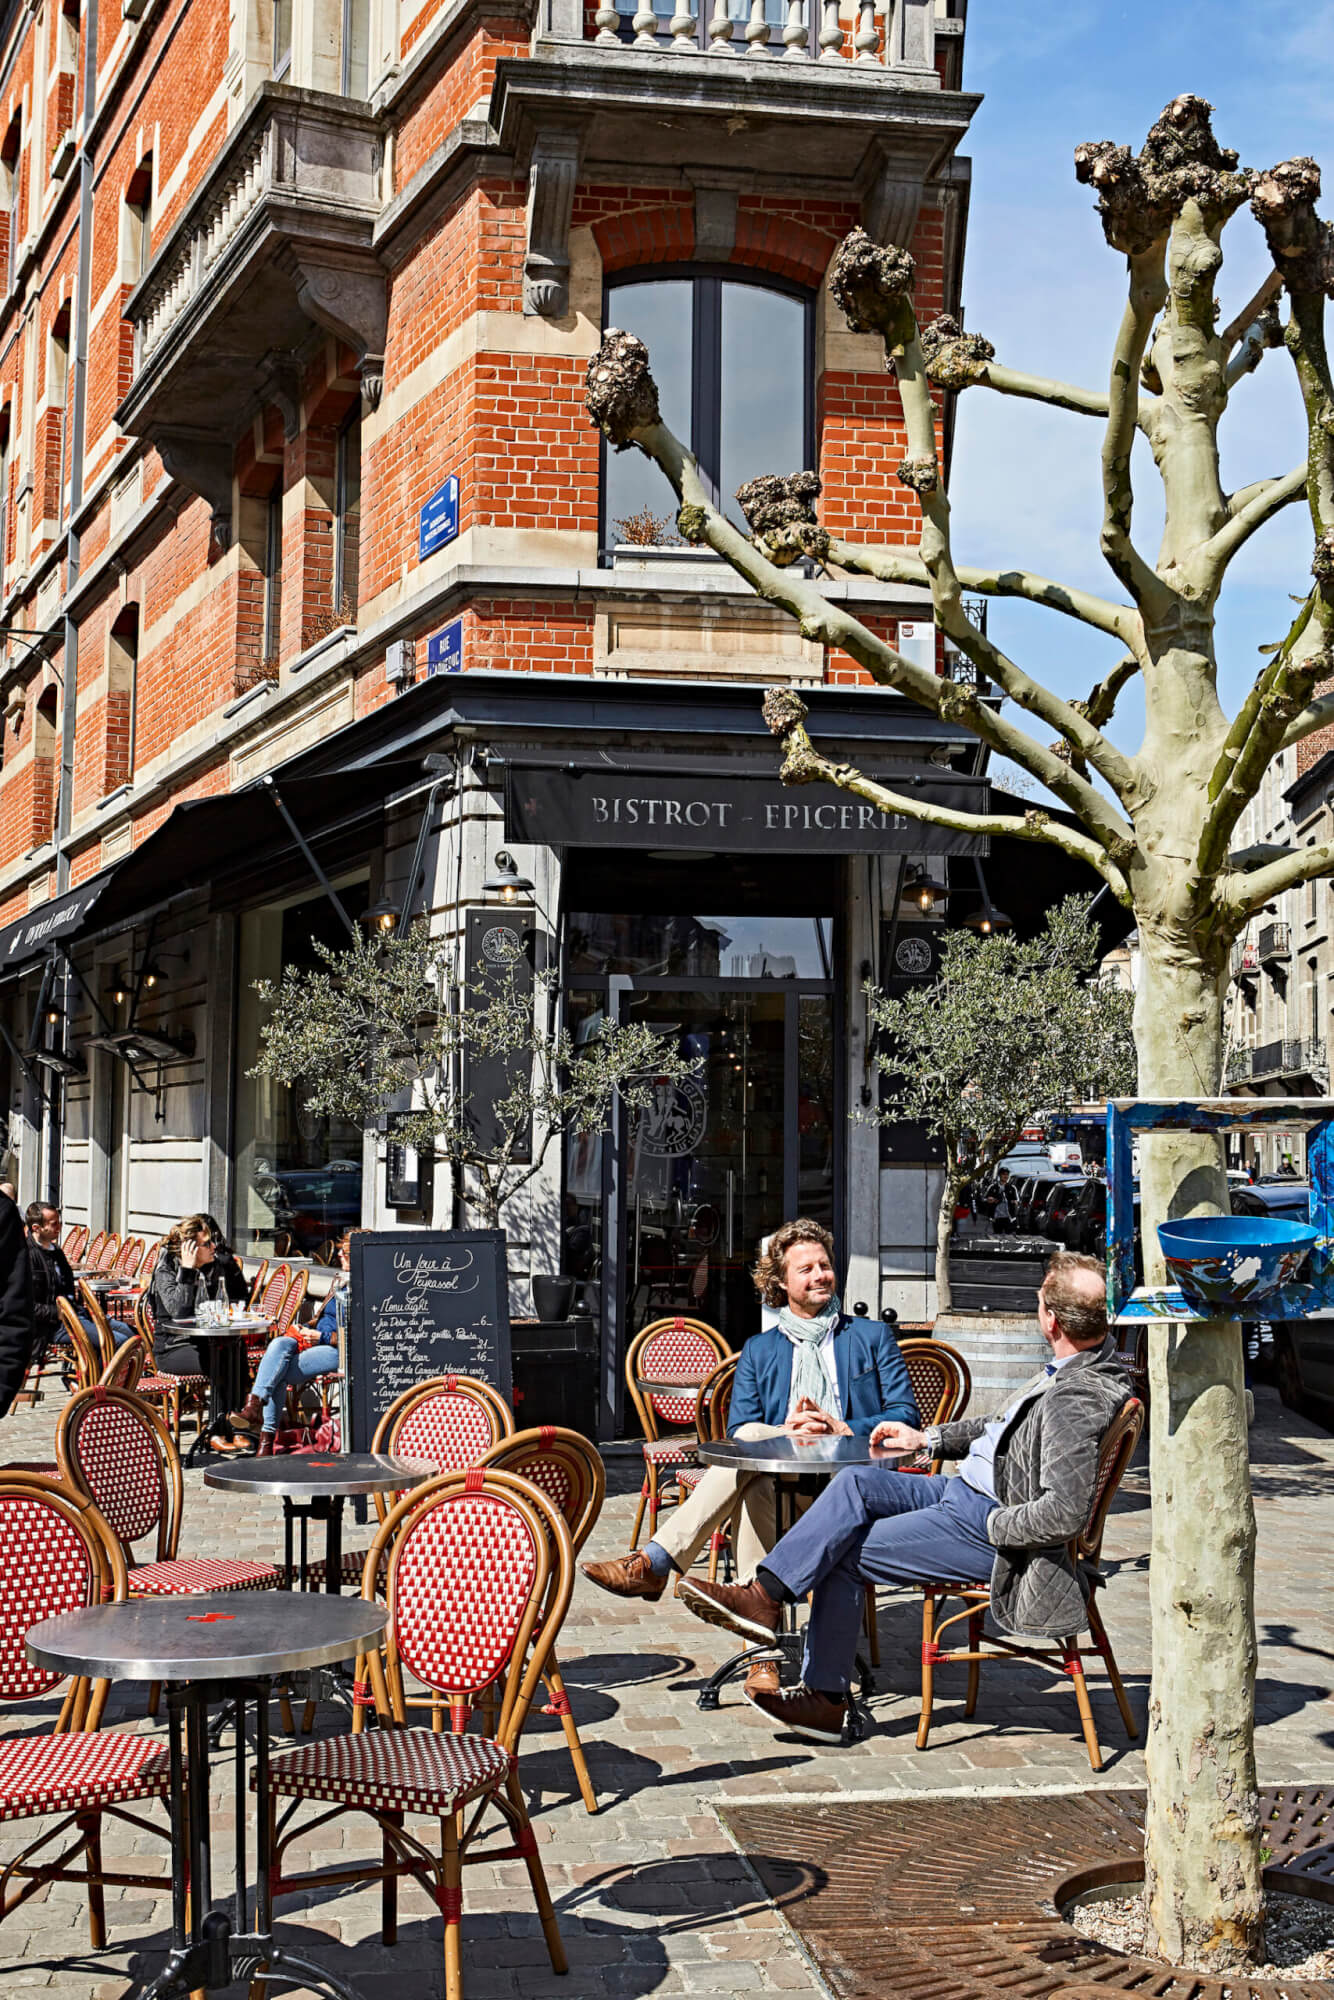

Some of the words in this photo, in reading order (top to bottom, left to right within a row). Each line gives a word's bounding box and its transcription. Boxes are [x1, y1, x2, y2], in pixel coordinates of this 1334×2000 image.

[440, 635, 450, 655] RUE
[592, 797, 733, 827] BISTROT
[764, 804, 908, 830] EPICERIE
[393, 1251, 411, 1269] Un
[411, 1270, 459, 1293] Peyrassol
